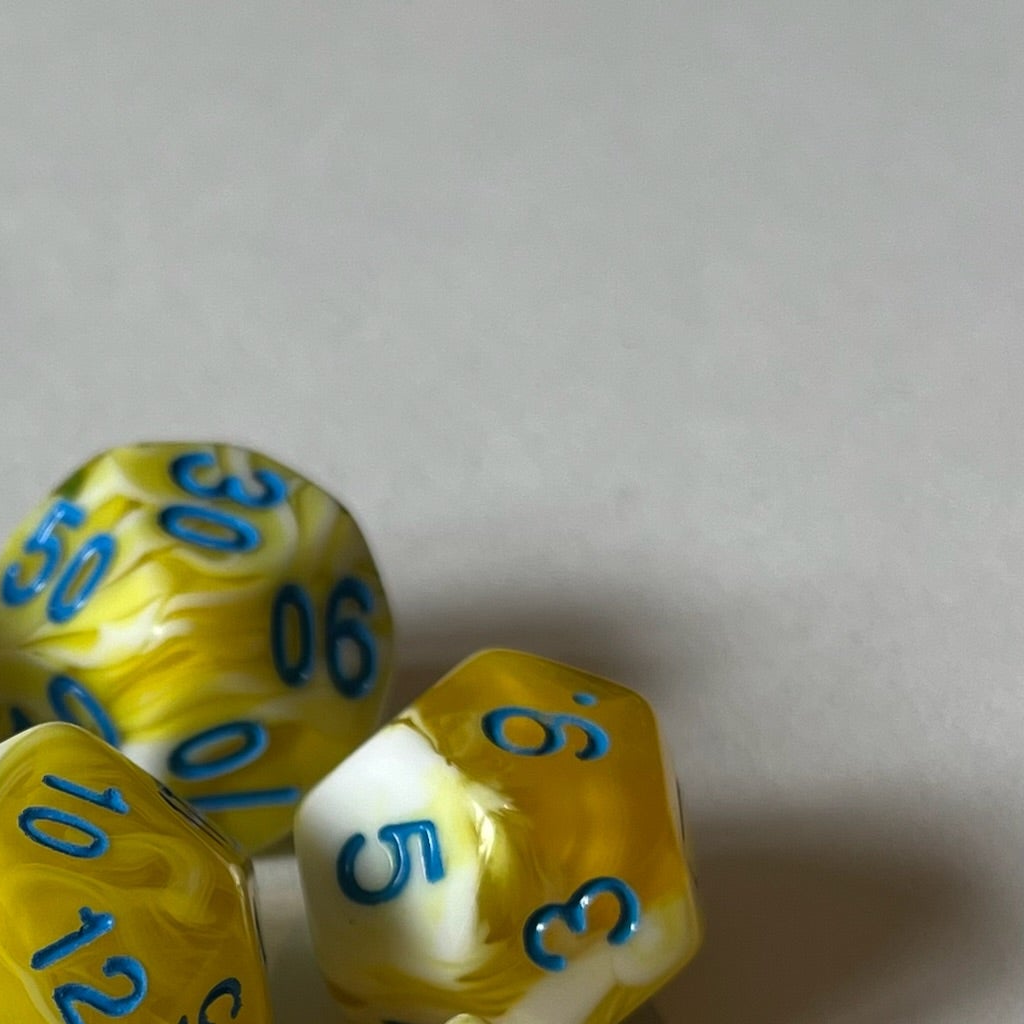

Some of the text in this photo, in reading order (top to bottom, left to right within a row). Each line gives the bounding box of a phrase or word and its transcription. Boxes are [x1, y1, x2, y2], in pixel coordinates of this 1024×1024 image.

[160, 451, 291, 554] 30
[0, 498, 117, 624] 50
[270, 576, 379, 699] 90
[167, 720, 301, 812] 10
[18, 774, 130, 859] 10
[336, 819, 446, 905] 5
[523, 876, 640, 972] 3
